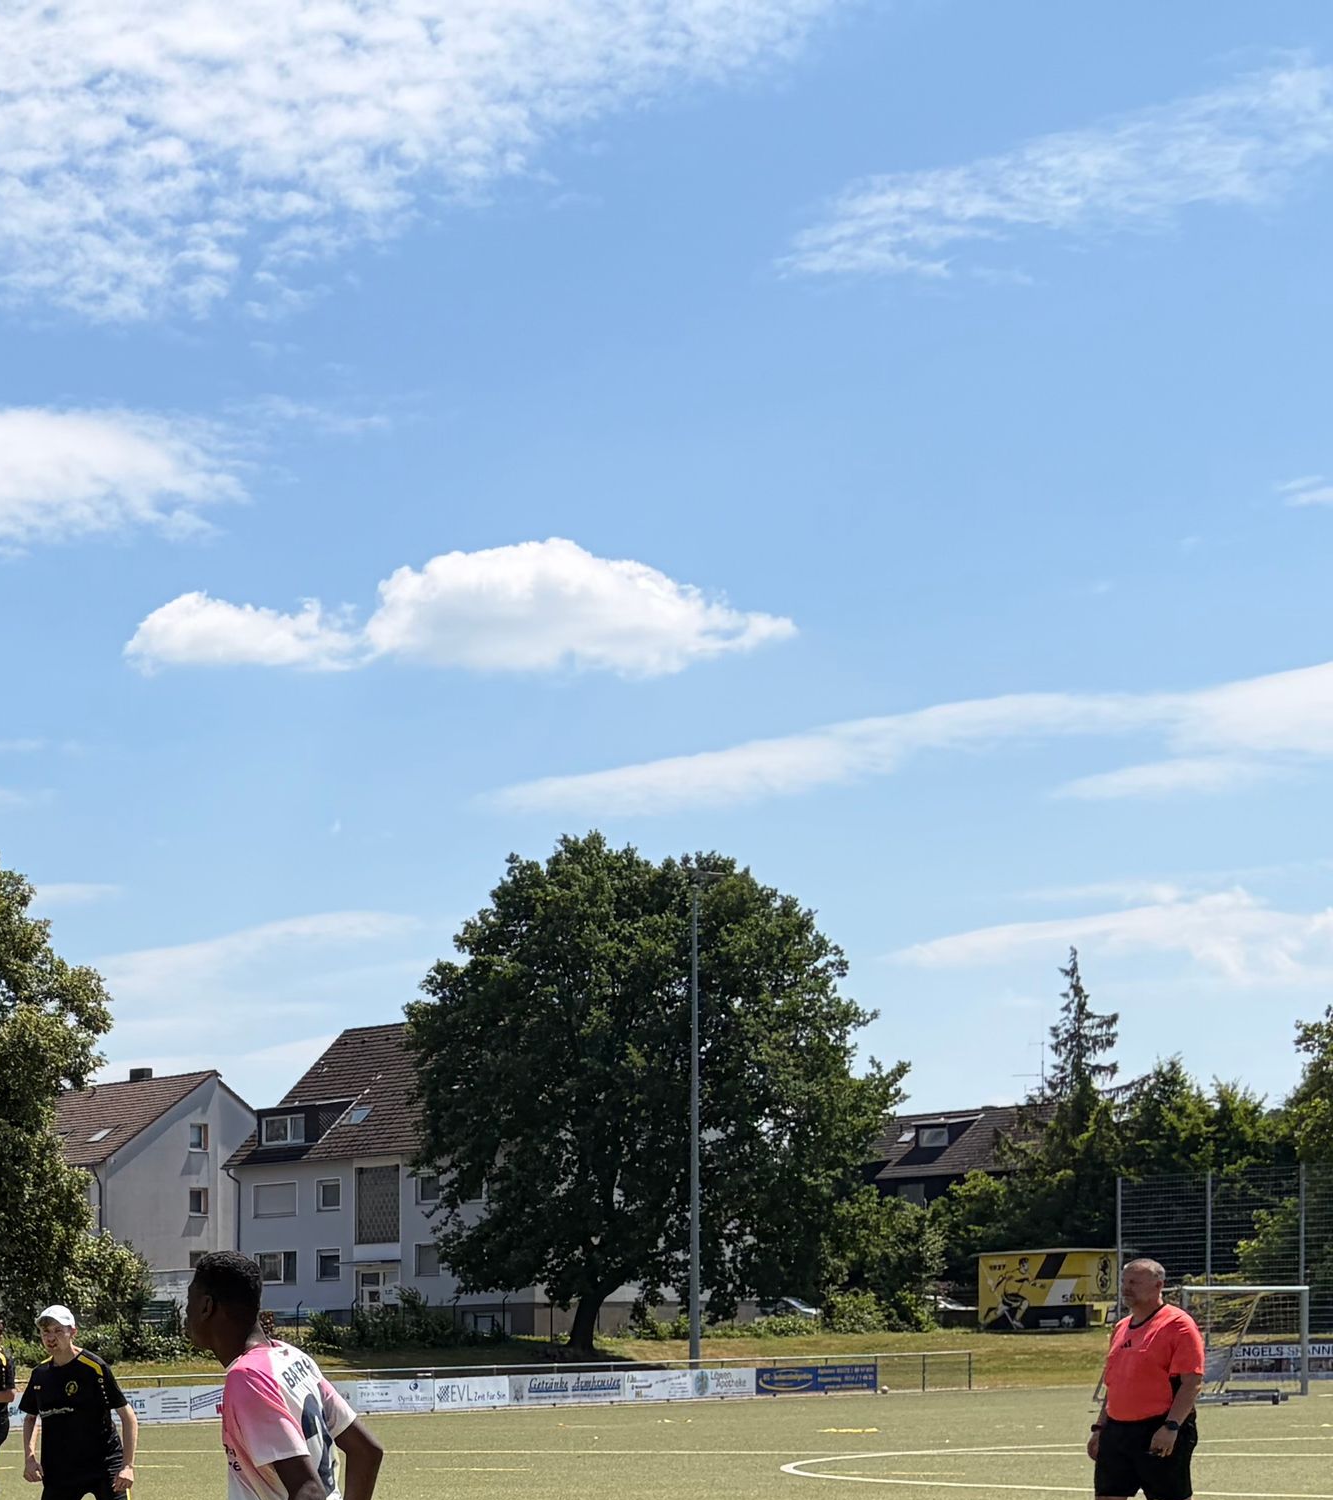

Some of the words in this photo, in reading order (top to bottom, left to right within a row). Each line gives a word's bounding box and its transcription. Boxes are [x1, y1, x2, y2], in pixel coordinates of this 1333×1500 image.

[1062, 1294, 1085, 1303] SSV
[529, 1378, 568, 1391] Getränke
[450, 1385, 473, 1403] EVL
